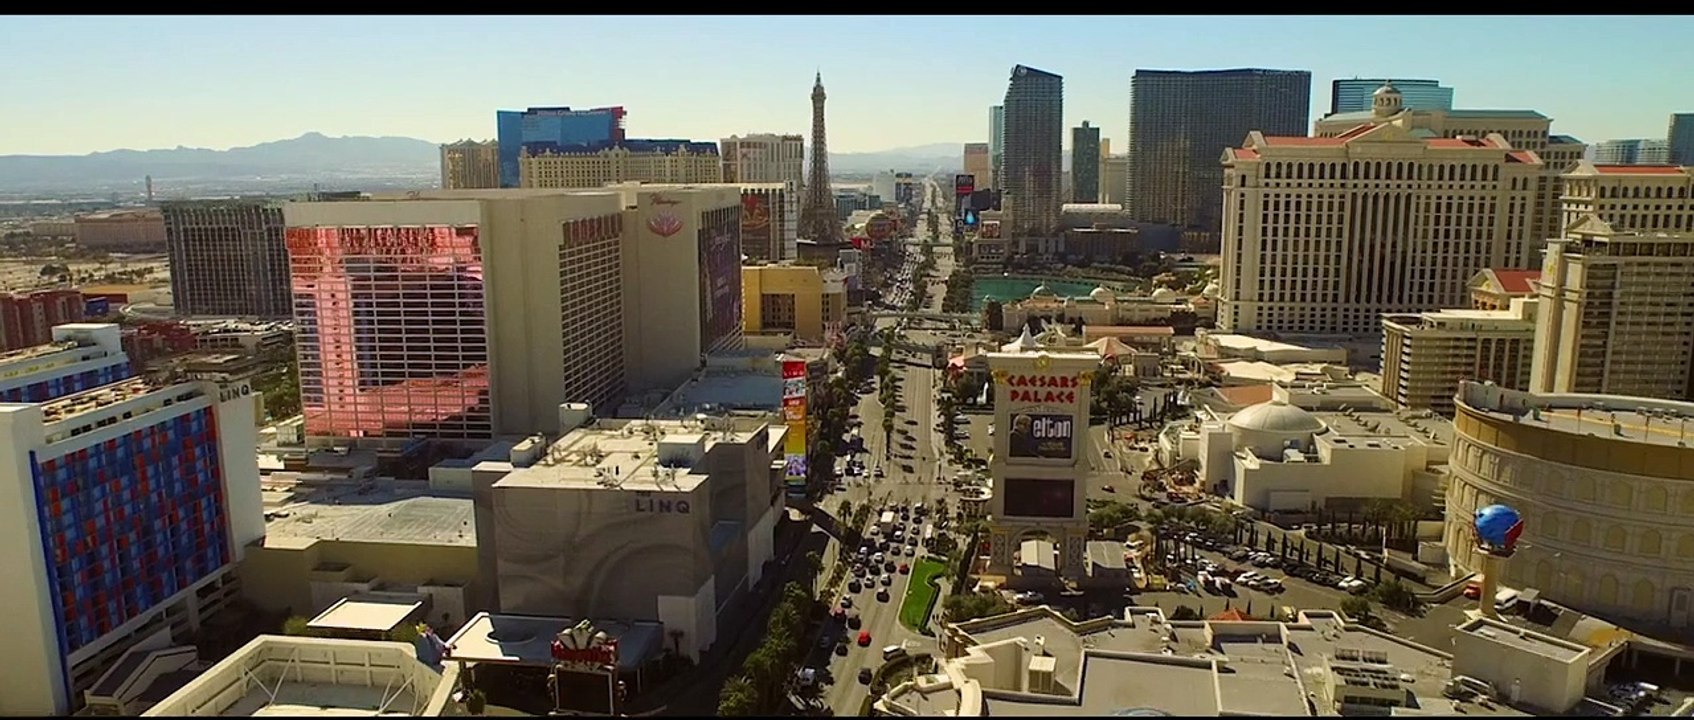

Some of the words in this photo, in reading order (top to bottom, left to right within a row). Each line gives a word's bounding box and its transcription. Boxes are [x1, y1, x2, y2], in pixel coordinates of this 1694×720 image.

[1007, 375, 1080, 388] CAESARS
[219, 385, 249, 402] LINQ
[1009, 390, 1076, 404] PALACE
[1033, 417, 1071, 438] elton
[636, 499, 690, 514] LINQ
